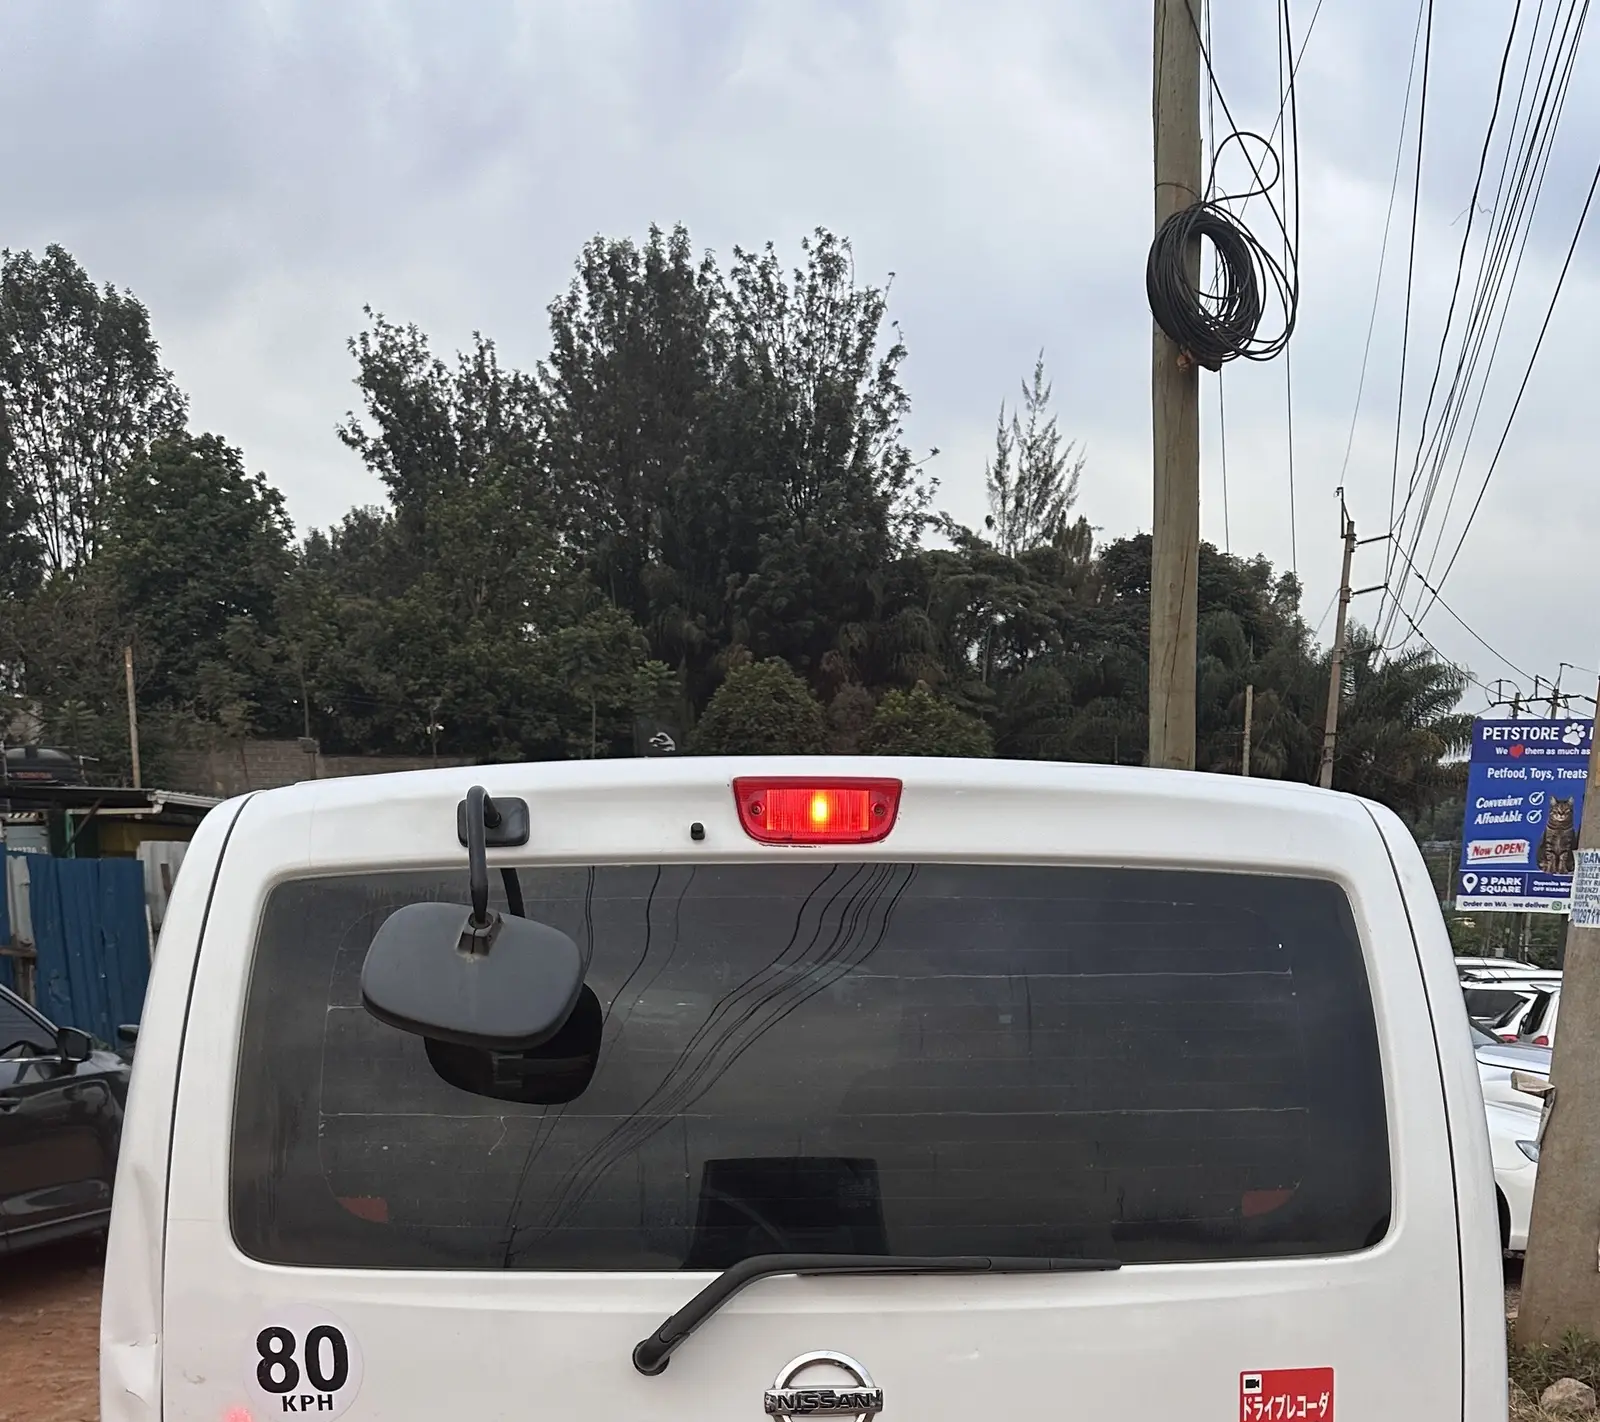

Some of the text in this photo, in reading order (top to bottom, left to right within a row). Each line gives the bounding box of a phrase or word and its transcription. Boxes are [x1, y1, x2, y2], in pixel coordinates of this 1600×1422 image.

[1482, 726, 1560, 741] PETSTORE
[1495, 747, 1508, 755] We
[1525, 747, 1544, 755] them
[1557, 747, 1580, 755] much
[1487, 767, 1588, 781] Petfood, Toys, Treats
[1472, 843, 1526, 857] Now OPEN!
[1480, 877, 1523, 886] 9 PARK
[1479, 885, 1521, 894] SQUARE
[1525, 901, 1549, 909] deliver
[256, 1324, 349, 1394] 80
[281, 1394, 334, 1412] KPH
[777, 1392, 872, 1411] NISSAN
[1243, 1391, 1331, 1422] ドライブレコーダ
